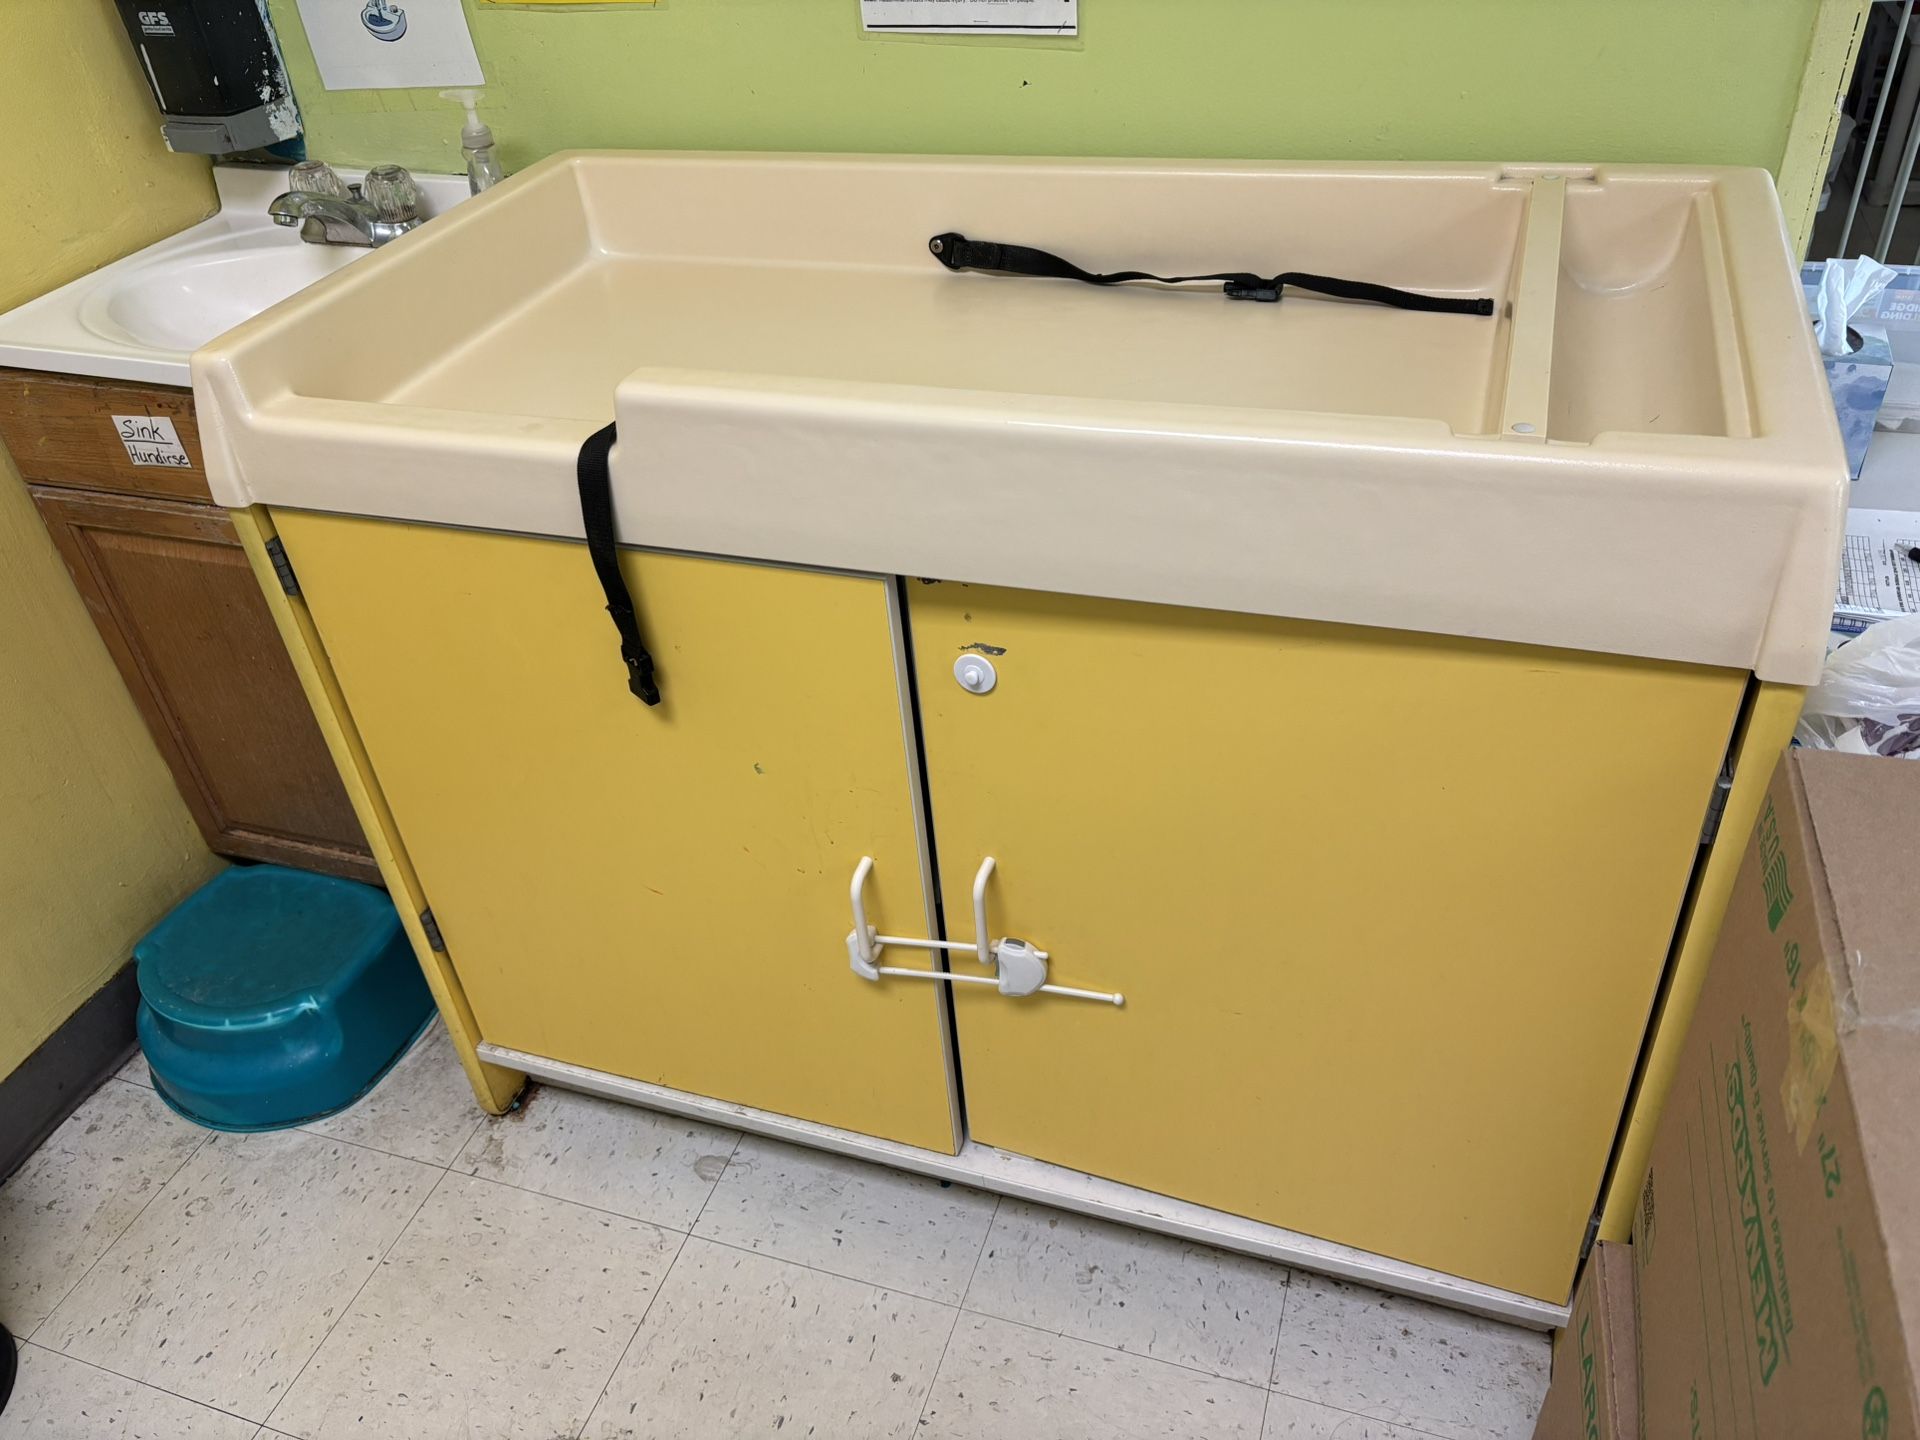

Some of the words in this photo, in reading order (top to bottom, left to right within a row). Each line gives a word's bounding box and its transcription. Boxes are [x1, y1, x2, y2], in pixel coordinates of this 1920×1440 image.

[138, 11, 170, 25] GFS
[121, 404, 165, 441] Sink
[128, 445, 189, 466] Hundirse
[1755, 1109, 1772, 1185] Service
[1766, 1187, 1776, 1214] to
[1726, 1062, 1779, 1387] MENARDS
[1771, 1216, 1794, 1335] Dedicated
